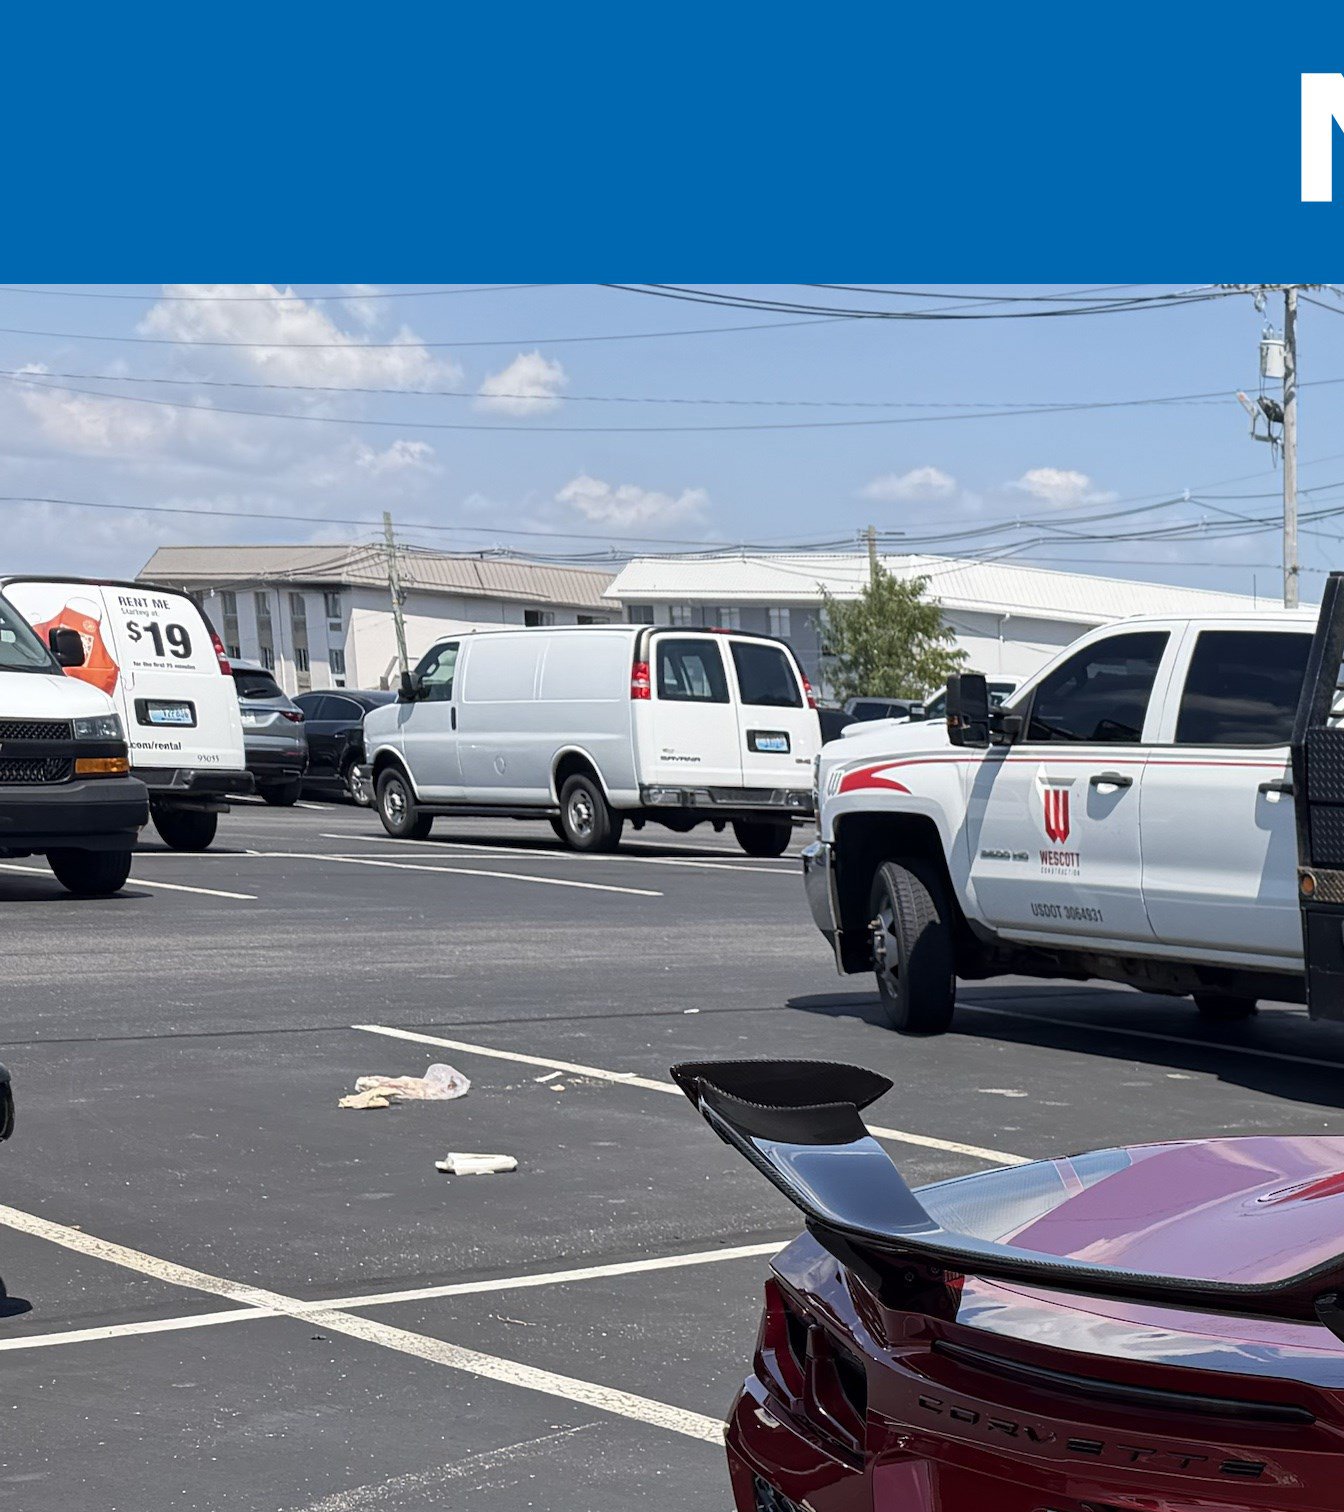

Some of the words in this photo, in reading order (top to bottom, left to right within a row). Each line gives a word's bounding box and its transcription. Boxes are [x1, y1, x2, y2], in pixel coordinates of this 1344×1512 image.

[118, 596, 148, 608] RENT
[152, 599, 171, 610] ME
[126, 620, 192, 659] $19
[1040, 850, 1080, 867] WESCOTT
[1041, 867, 1080, 876] CONSTRUCTION
[1030, 902, 1062, 919] USDOT
[918, 1394, 1267, 1479] CORVETTE
